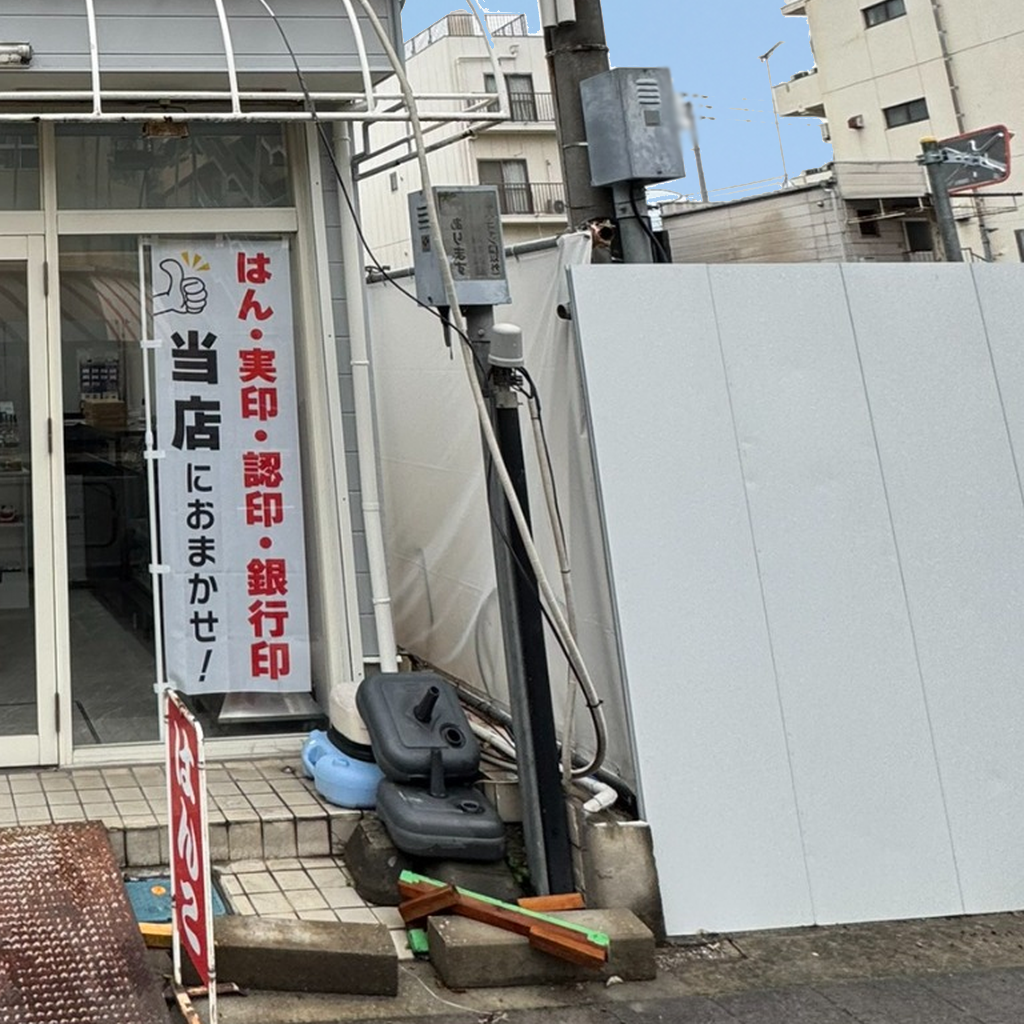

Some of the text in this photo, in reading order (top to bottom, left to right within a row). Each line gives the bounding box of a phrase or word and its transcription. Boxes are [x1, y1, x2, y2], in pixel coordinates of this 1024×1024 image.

[237, 252, 290, 680] はん・実印・認印・銀行印
